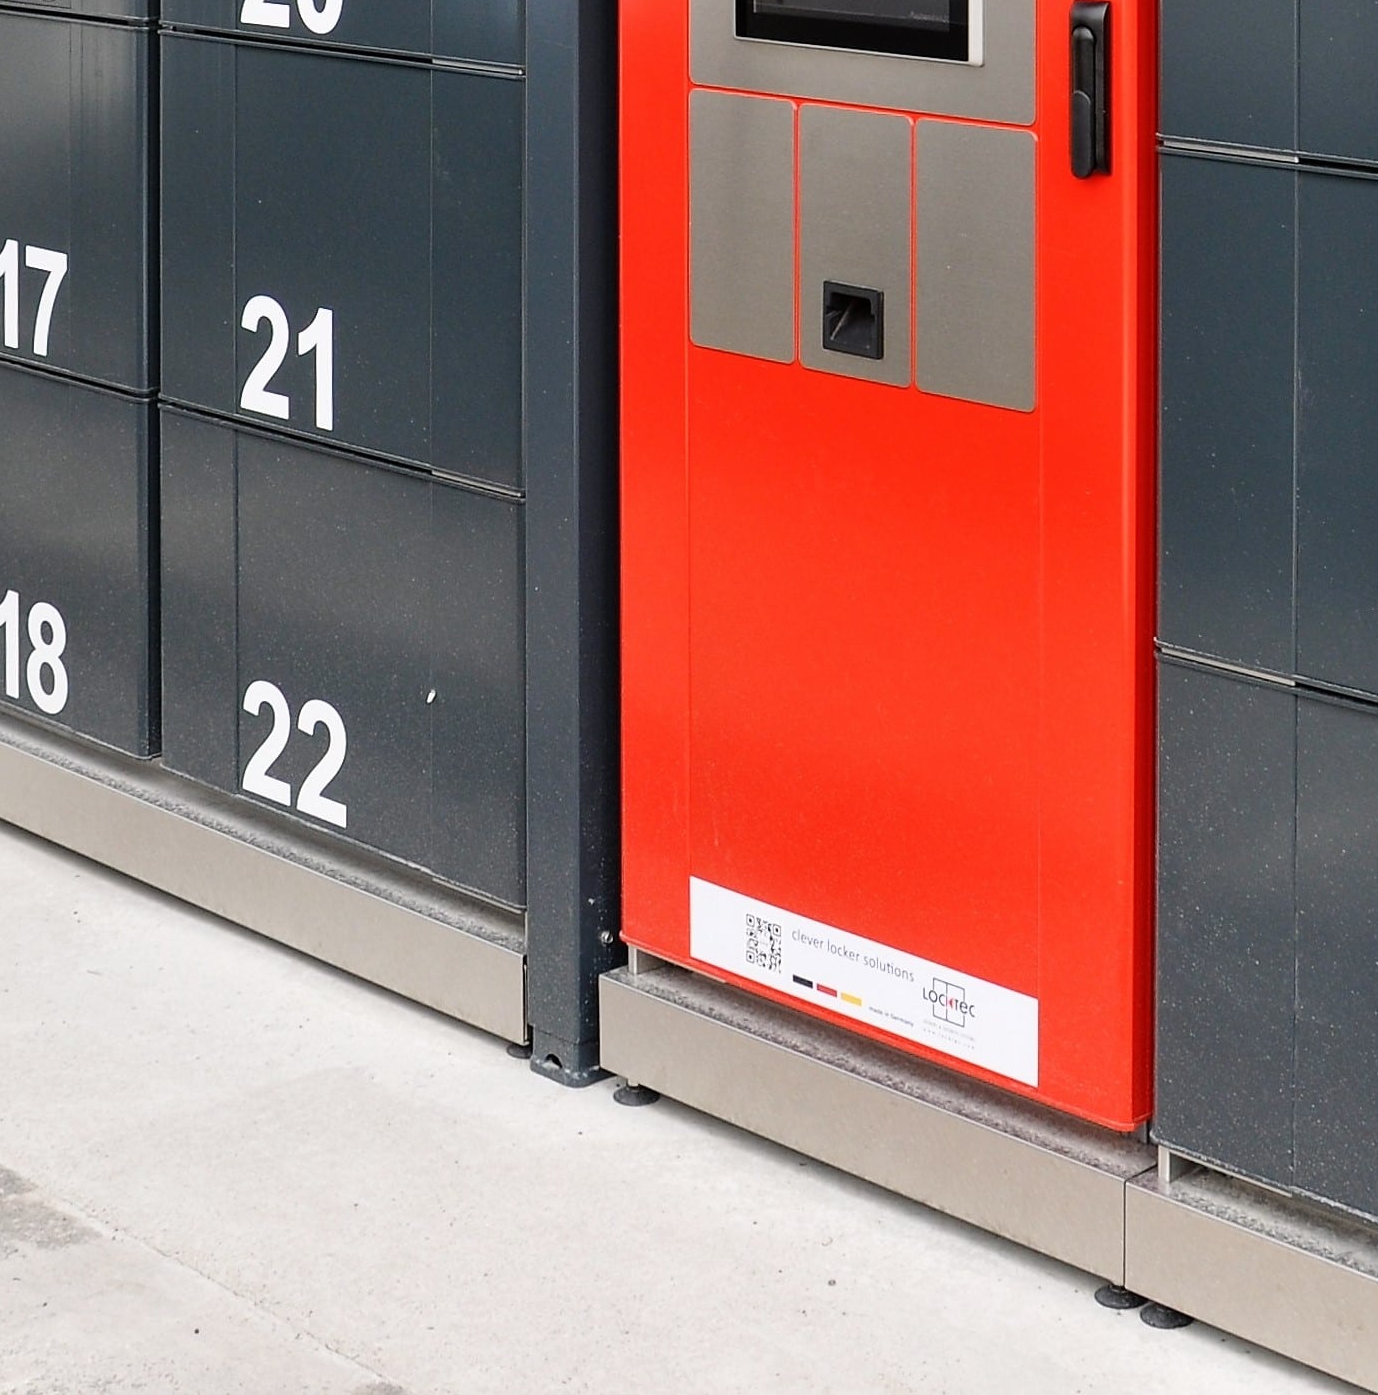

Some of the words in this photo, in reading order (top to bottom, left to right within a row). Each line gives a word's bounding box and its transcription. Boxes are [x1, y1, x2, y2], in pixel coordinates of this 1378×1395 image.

[240, 295, 333, 431] 21
[242, 680, 347, 829] 22
[791, 929, 824, 949] clever
[827, 939, 860, 963] locker
[863, 956, 915, 983] solutions
